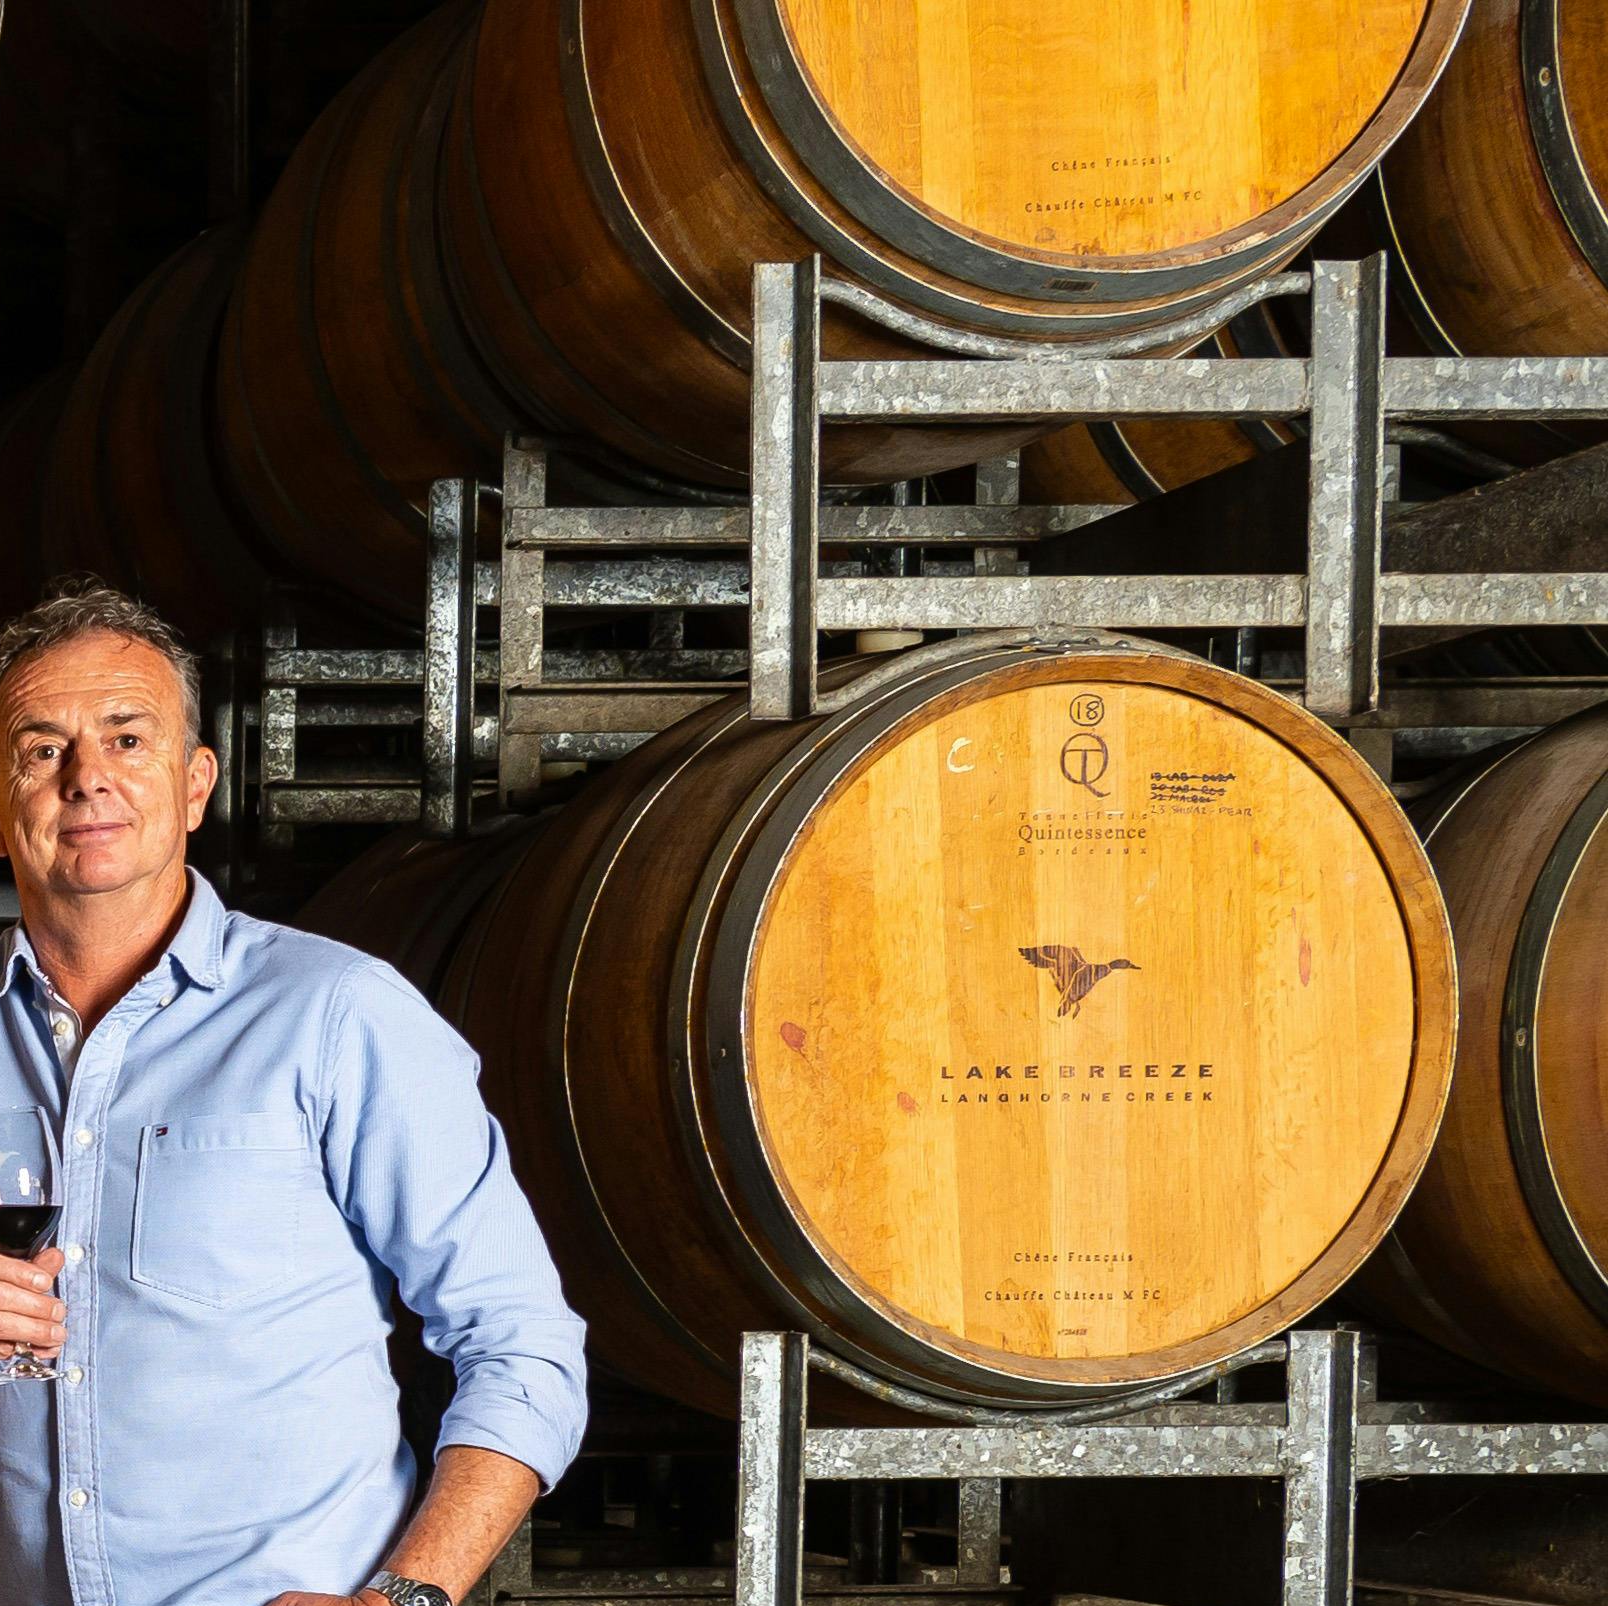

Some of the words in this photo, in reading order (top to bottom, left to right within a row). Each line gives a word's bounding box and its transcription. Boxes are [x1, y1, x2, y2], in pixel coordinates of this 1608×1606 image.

[1025, 200, 1084, 213] Chauffe
[1183, 190, 1201, 200] FC
[1077, 700, 1100, 721] 18
[947, 737, 975, 773] C
[1018, 825, 1147, 843] Quintessence
[941, 1065, 1039, 1079] LAKE
[1059, 1064, 1213, 1079] BREEZE
[941, 1092, 1111, 1103] LANGHORNE
[1126, 1091, 1212, 1102] CREEK
[984, 1290, 1044, 1301] Chauffe
[1054, 1290, 1113, 1301] Château
[1123, 1290, 1134, 1300] M
[1143, 1289, 1161, 1300] FC
